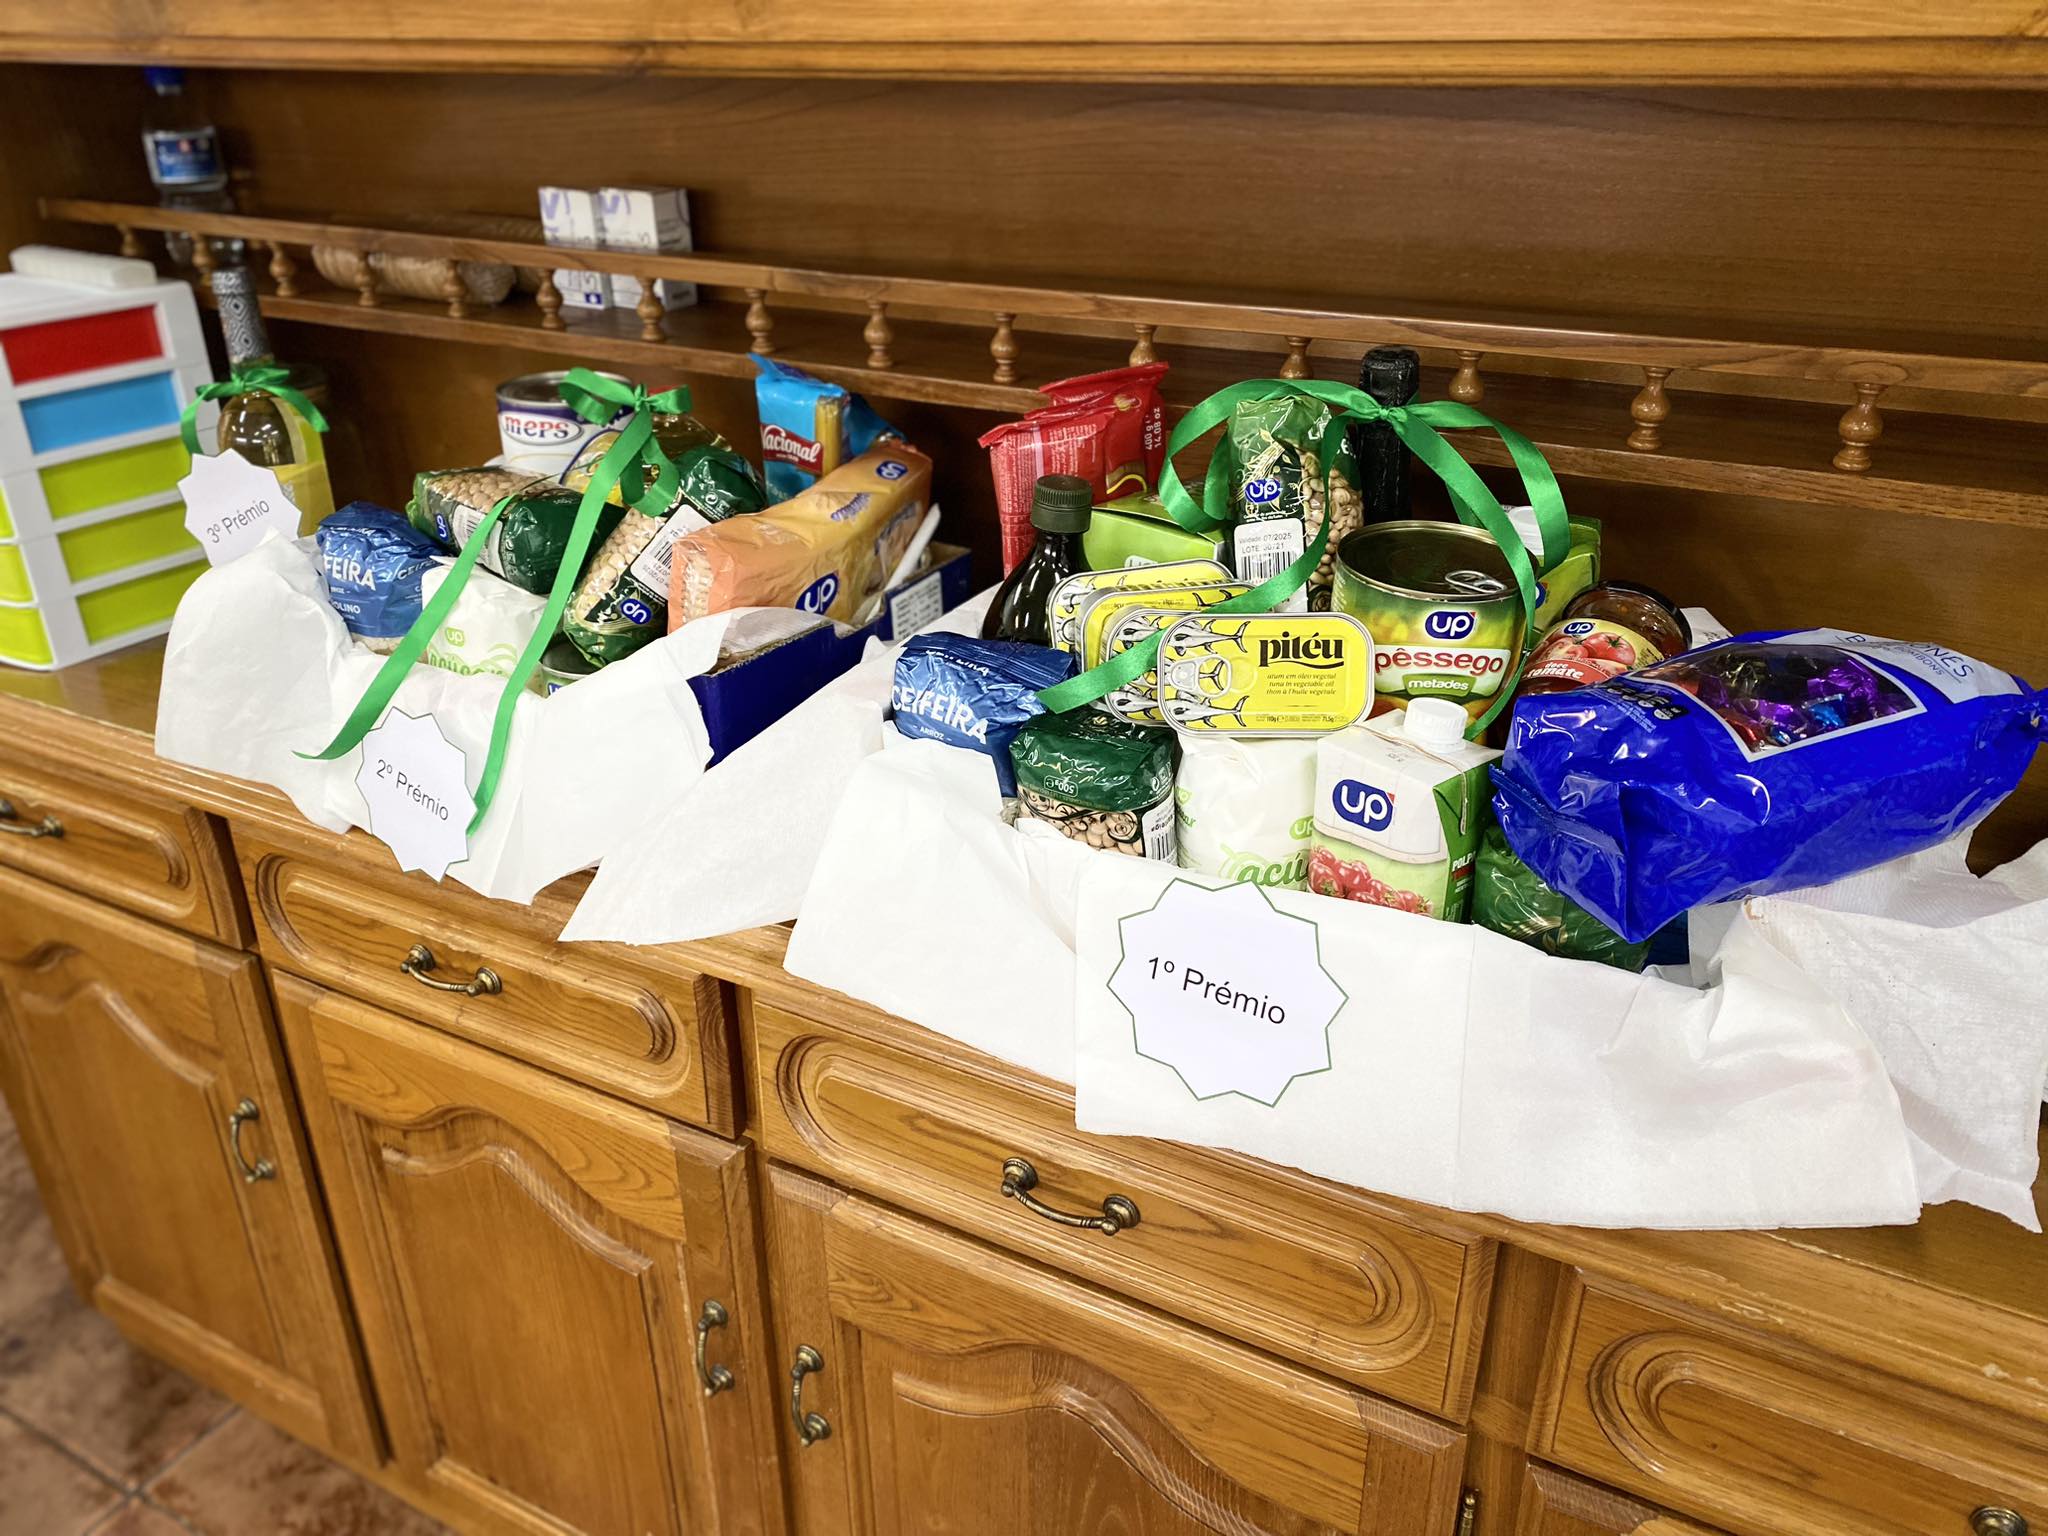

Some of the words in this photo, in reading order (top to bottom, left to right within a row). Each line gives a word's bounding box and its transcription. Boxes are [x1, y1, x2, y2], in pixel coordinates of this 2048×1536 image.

[220, 499, 270, 535] Prémio
[323, 553, 377, 592] FEIRA
[332, 600, 361, 614] OLINO
[1258, 630, 1345, 668] pitéu
[1375, 646, 1504, 677] pêssego
[1407, 678, 1470, 692] metades
[891, 685, 989, 745] CEIFEIRA
[919, 725, 945, 741] ARROZ
[395, 771, 449, 821] Prémio
[1182, 966, 1286, 1025] Prémio
